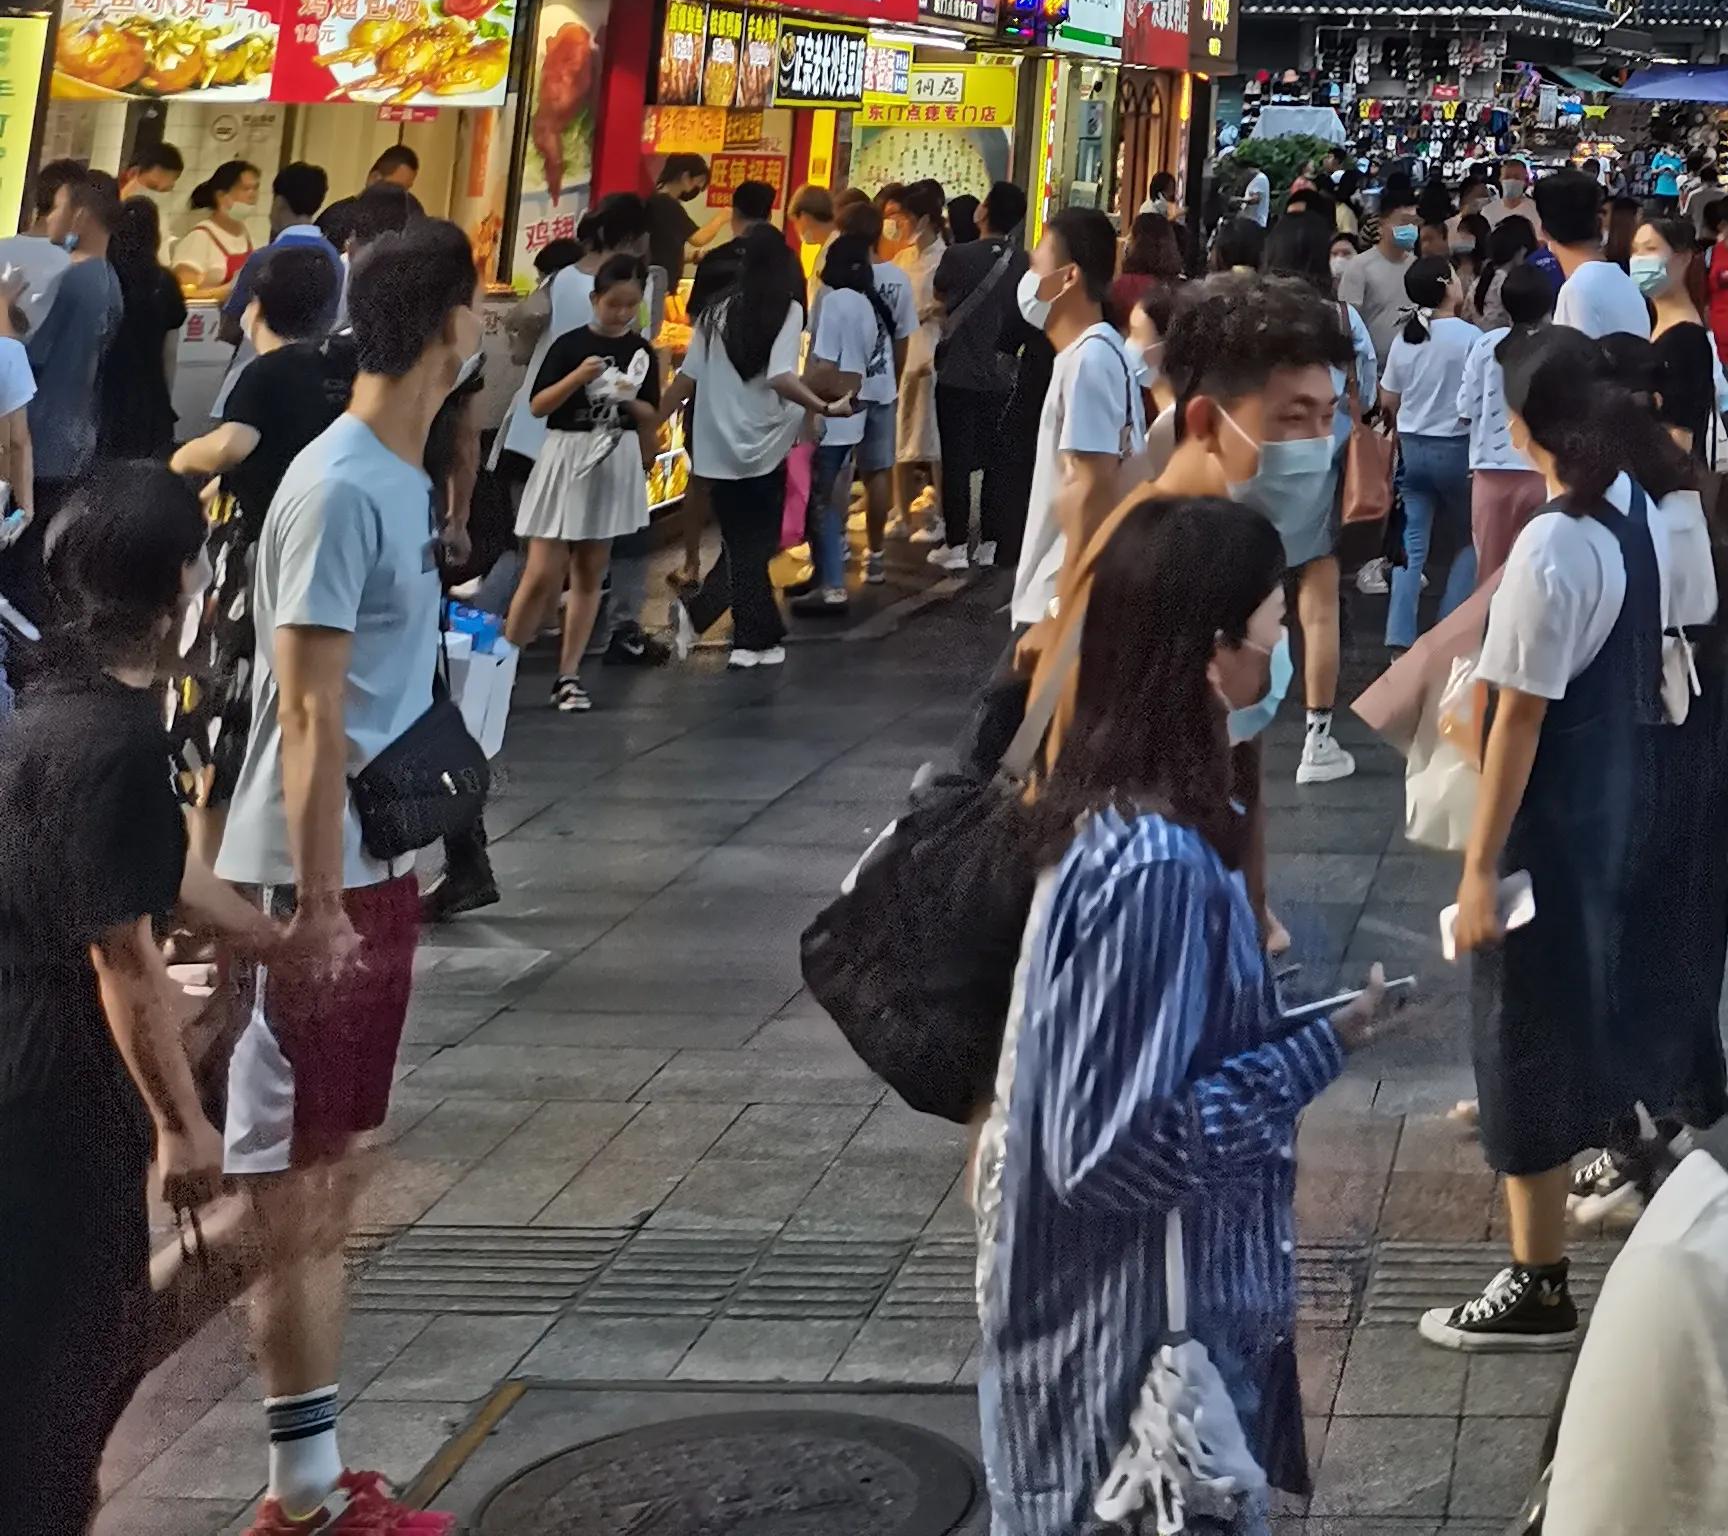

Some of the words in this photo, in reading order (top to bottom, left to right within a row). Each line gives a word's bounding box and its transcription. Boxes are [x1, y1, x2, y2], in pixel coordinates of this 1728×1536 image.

[868, 103, 997, 123] 东门点痣专门店
